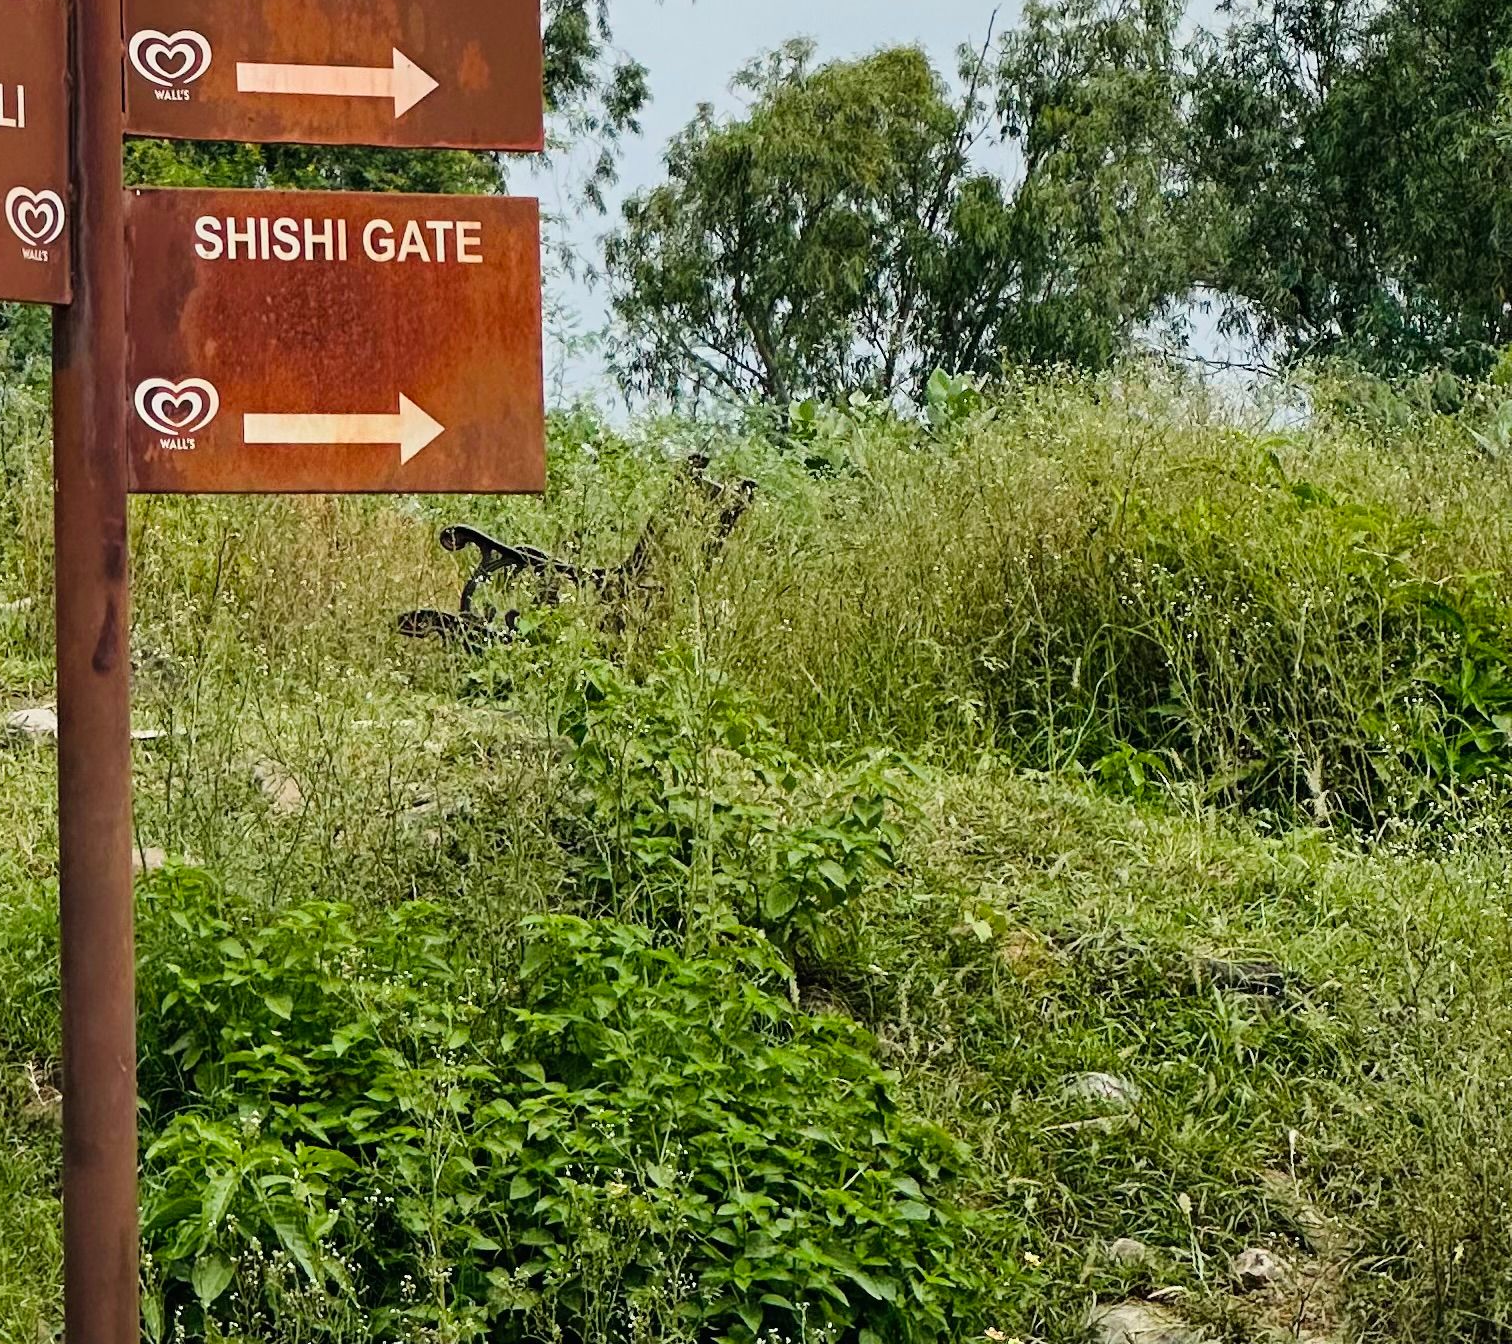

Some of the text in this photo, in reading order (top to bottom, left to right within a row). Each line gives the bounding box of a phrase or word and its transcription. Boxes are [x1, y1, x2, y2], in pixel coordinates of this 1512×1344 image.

[154, 88, 190, 101] WALL'S
[194, 215, 484, 264] SHISHI GATE
